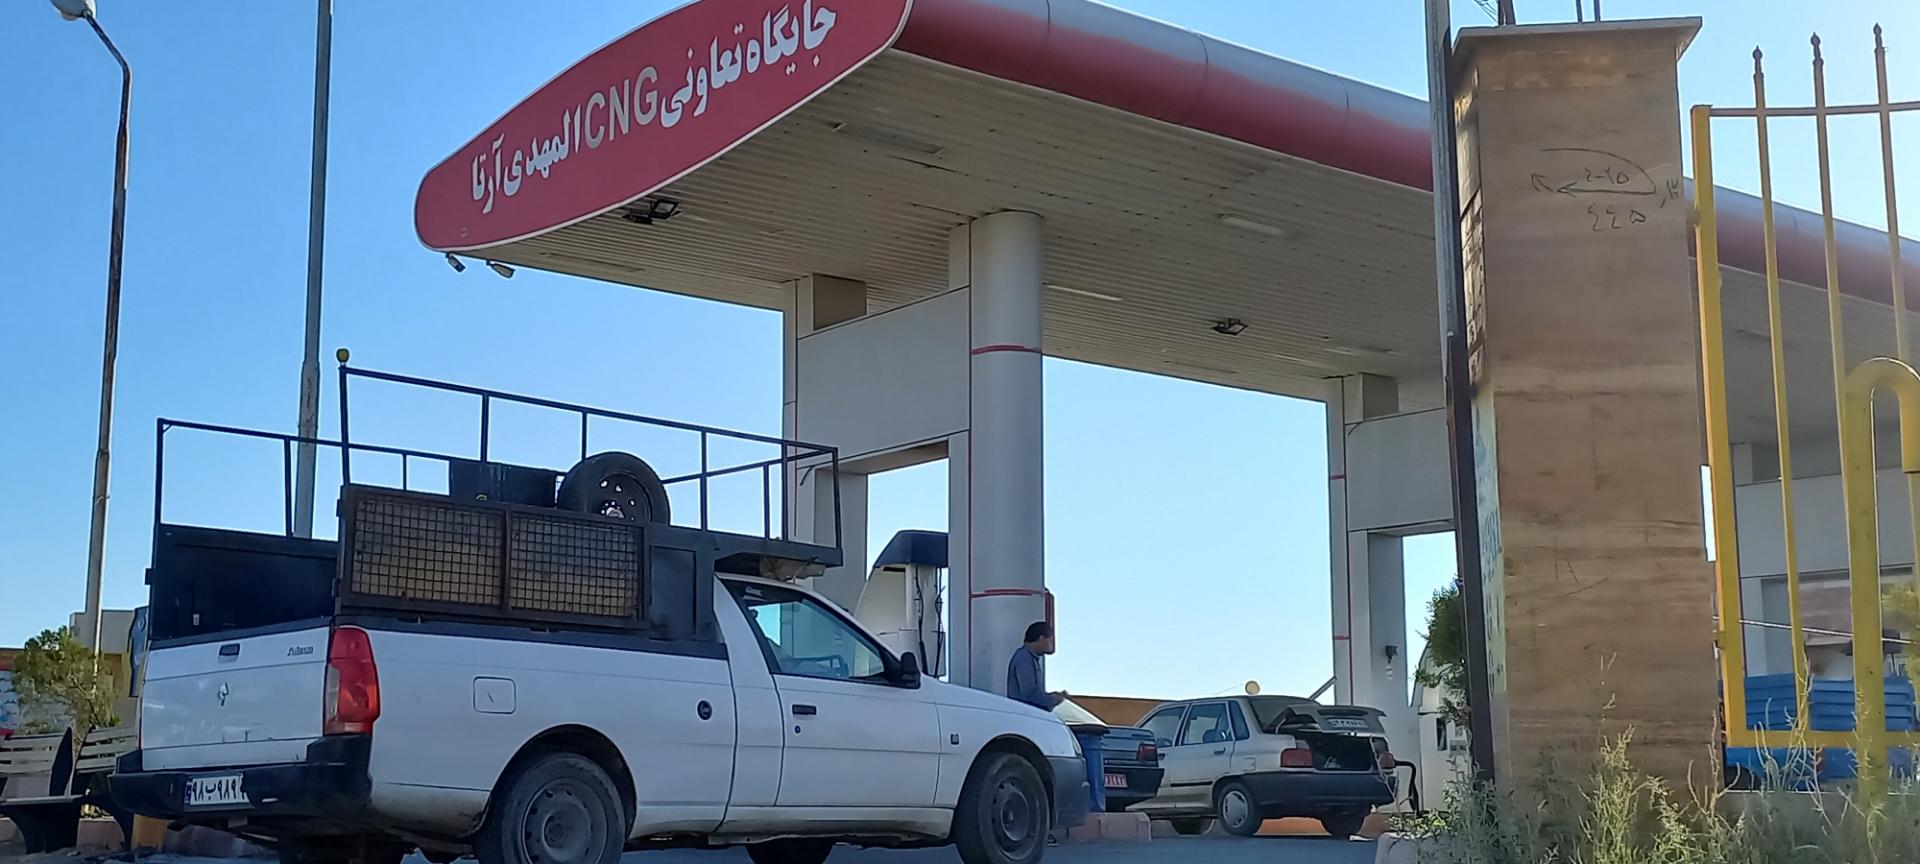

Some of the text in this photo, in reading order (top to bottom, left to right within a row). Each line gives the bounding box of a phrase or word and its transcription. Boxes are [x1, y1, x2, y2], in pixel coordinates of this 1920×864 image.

[472, 0, 836, 214] جایگاه تعاونی CNG المهدی آرتا
